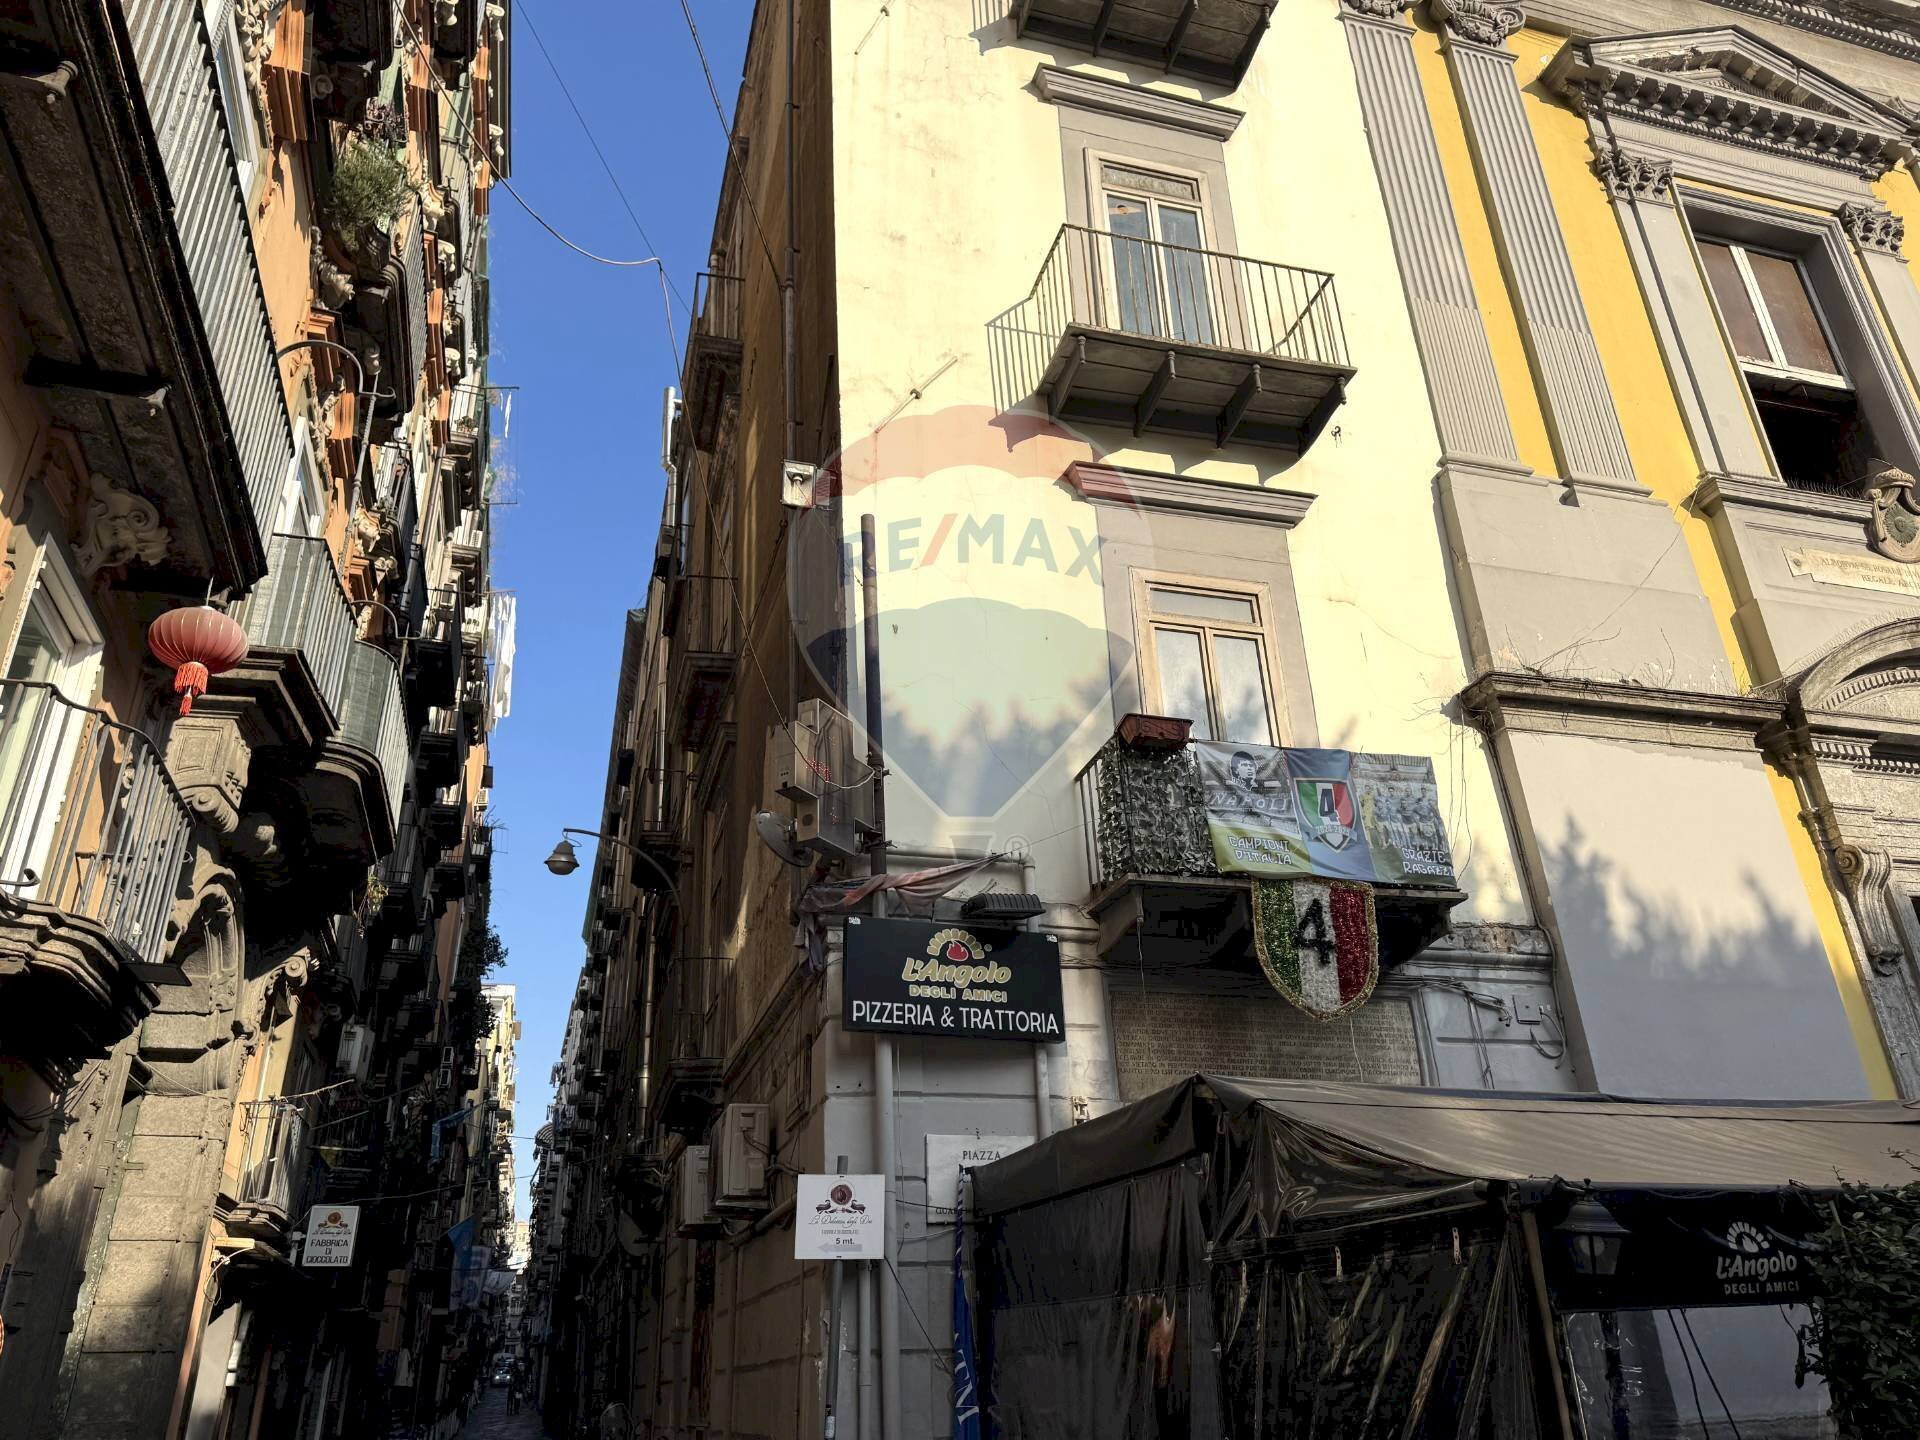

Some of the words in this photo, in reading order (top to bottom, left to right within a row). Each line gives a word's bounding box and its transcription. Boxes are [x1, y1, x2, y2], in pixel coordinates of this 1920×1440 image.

[1209, 791, 1289, 811] NAPOLI
[1318, 787, 1341, 824] 4
[1228, 835, 1290, 854] CAMPIONI
[1234, 849, 1293, 866] D'ITALIA
[1401, 847, 1446, 863] GRAZIE
[1293, 898, 1336, 966] 4
[902, 957, 1012, 988] L'Angolo
[908, 985, 956, 1000] DEGLI
[962, 988, 1008, 1003] AMICI
[852, 1000, 935, 1026] PIZZERIA
[940, 1005, 955, 1028] &
[959, 1007, 1060, 1034] TRATTORIA
[962, 1150, 1001, 1161] PIAZZA
[311, 1239, 348, 1247] FABBRICA
[835, 1237, 841, 1245] 5
[842, 1237, 855, 1245] mt.
[325, 1247, 332, 1255] DI
[1715, 1250, 1798, 1281] L'Angolo
[1724, 1282, 1760, 1296] DEGLI
[1765, 1280, 1800, 1294] AMICI
